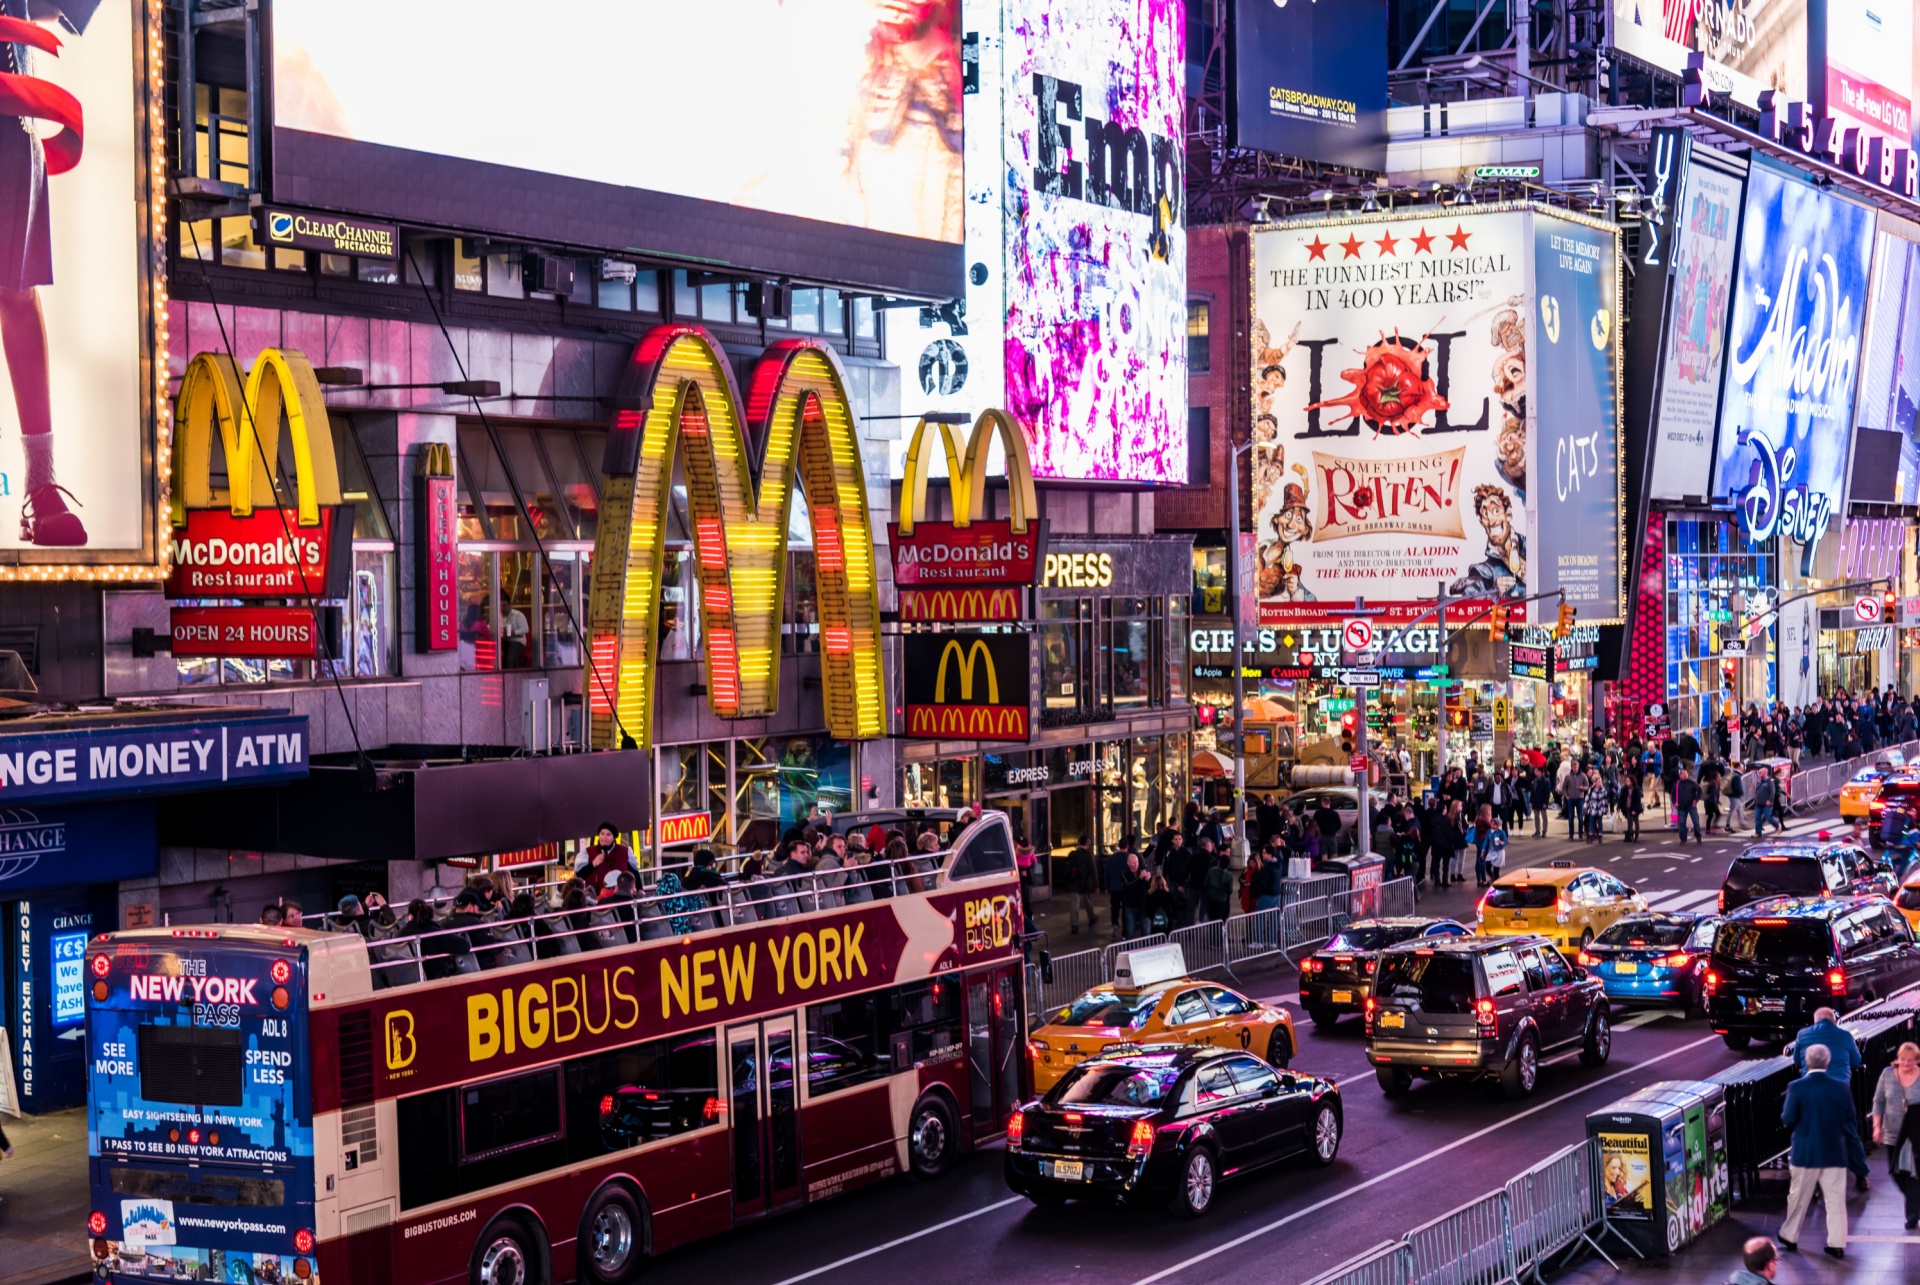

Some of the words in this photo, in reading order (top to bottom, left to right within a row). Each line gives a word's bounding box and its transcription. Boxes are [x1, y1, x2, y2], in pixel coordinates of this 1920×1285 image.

[1269, 86, 1356, 114] CATSBROADWAY.COM
[1841, 78, 1855, 108] The
[1856, 88, 1881, 120] all-new
[1882, 100, 1892, 126] LG
[1482, 168, 1534, 176] LAMAR
[334, 238, 392, 256] SPECTACOLOR
[1550, 235, 1561, 250] LET
[1562, 237, 1575, 254] THE
[1576, 240, 1600, 260] MEMORY
[1270, 268, 1308, 288] THE
[1314, 261, 1414, 285] FUNNIEST
[1420, 253, 1511, 279] MUSICAL
[1560, 254, 1572, 270] LIVE
[1574, 256, 1592, 274] AGAIN
[1305, 288, 1331, 311] IN
[1338, 287, 1384, 309] 400
[1774, 398, 1808, 416] BROADWAY
[1809, 402, 1834, 420] MUSICAL
[1334, 456, 1442, 474] SOMETHING
[1556, 430, 1598, 502] CATS
[437, 487, 448, 545] OPEN
[1365, 522, 1404, 531] BROADWAY
[1408, 522, 1433, 532] SMASH
[172, 537, 320, 566] McDonald's
[436, 551, 451, 562] 24
[898, 541, 1029, 564] McDonald's
[1336, 550, 1350, 558] THE
[1354, 550, 1390, 558] DIRECTOR
[1404, 546, 1460, 556] ALADDIN
[1836, 518, 1906, 579] FOREVER
[1424, 558, 1434, 566] OF
[192, 570, 294, 587] Restaurant
[919, 565, 1007, 580] Restaurant
[1316, 569, 1341, 579] THE
[1344, 568, 1378, 578] BOOK
[1382, 568, 1398, 578] OF
[1400, 567, 1458, 578] MORMON
[438, 569, 450, 641] HOURS
[1458, 607, 1465, 616] &
[1467, 606, 1482, 616] 8TH
[174, 626, 219, 642] OPEN
[225, 626, 245, 642] 24
[250, 626, 310, 642] HOURS
[1300, 629, 1449, 653] LUGAGE
[1855, 627, 1884, 652] FOREVER
[1313, 652, 1340, 666] NY
[1570, 658, 1585, 670] SONY
[1203, 668, 1222, 678] Apple
[1271, 668, 1312, 679] Canon
[1328, 702, 1334, 710] W
[1338, 702, 1346, 710] 46
[1496, 700, 1504, 726] ATM
[89, 738, 215, 780] MONEY
[235, 732, 302, 768] ATM
[1008, 765, 1049, 784] EXPRESS
[1069, 758, 1107, 776] EXPRESS
[53, 913, 94, 929] CHANGE
[964, 898, 992, 928] BIG
[20, 901, 30, 972] MONEY
[966, 925, 992, 954] BUS
[60, 966, 78, 978] We
[178, 959, 206, 976] THE
[130, 974, 184, 1001] NEW
[189, 976, 258, 1005] YORK
[466, 965, 640, 1062] BIGBUS
[660, 941, 757, 1020] NEW
[768, 920, 868, 994] YORK
[193, 1004, 240, 1026] PASS
[262, 1019, 280, 1036] ADL
[282, 1020, 288, 1037] 8
[22, 982, 32, 1096] EXCHANGE
[103, 1042, 126, 1058] SEE
[246, 1050, 292, 1067] SPEND
[96, 1060, 134, 1076] MORE
[253, 1068, 284, 1085] LESS
[390, 1072, 400, 1080] NEW
[401, 1070, 414, 1078] YORK
[122, 1109, 144, 1120] EASY
[146, 1110, 201, 1123] SIGHTSEEING
[204, 1114, 213, 1124] IN
[216, 1115, 236, 1126] NEW
[238, 1116, 263, 1128] YORK
[104, 1140, 109, 1148] 1
[112, 1140, 132, 1150] PASS
[134, 1141, 146, 1151] TO
[148, 1142, 163, 1152] SEE
[166, 1144, 176, 1153] 80
[178, 1144, 198, 1154] NEW
[200, 1146, 224, 1158] YORK
[226, 1147, 287, 1162] ATTRACTIONS
[1601, 1136, 1648, 1150] Beautiful
[178, 1216, 286, 1234] www.newyorkpass.com
[404, 1209, 478, 1238] BIGBUSTOURS.COM
